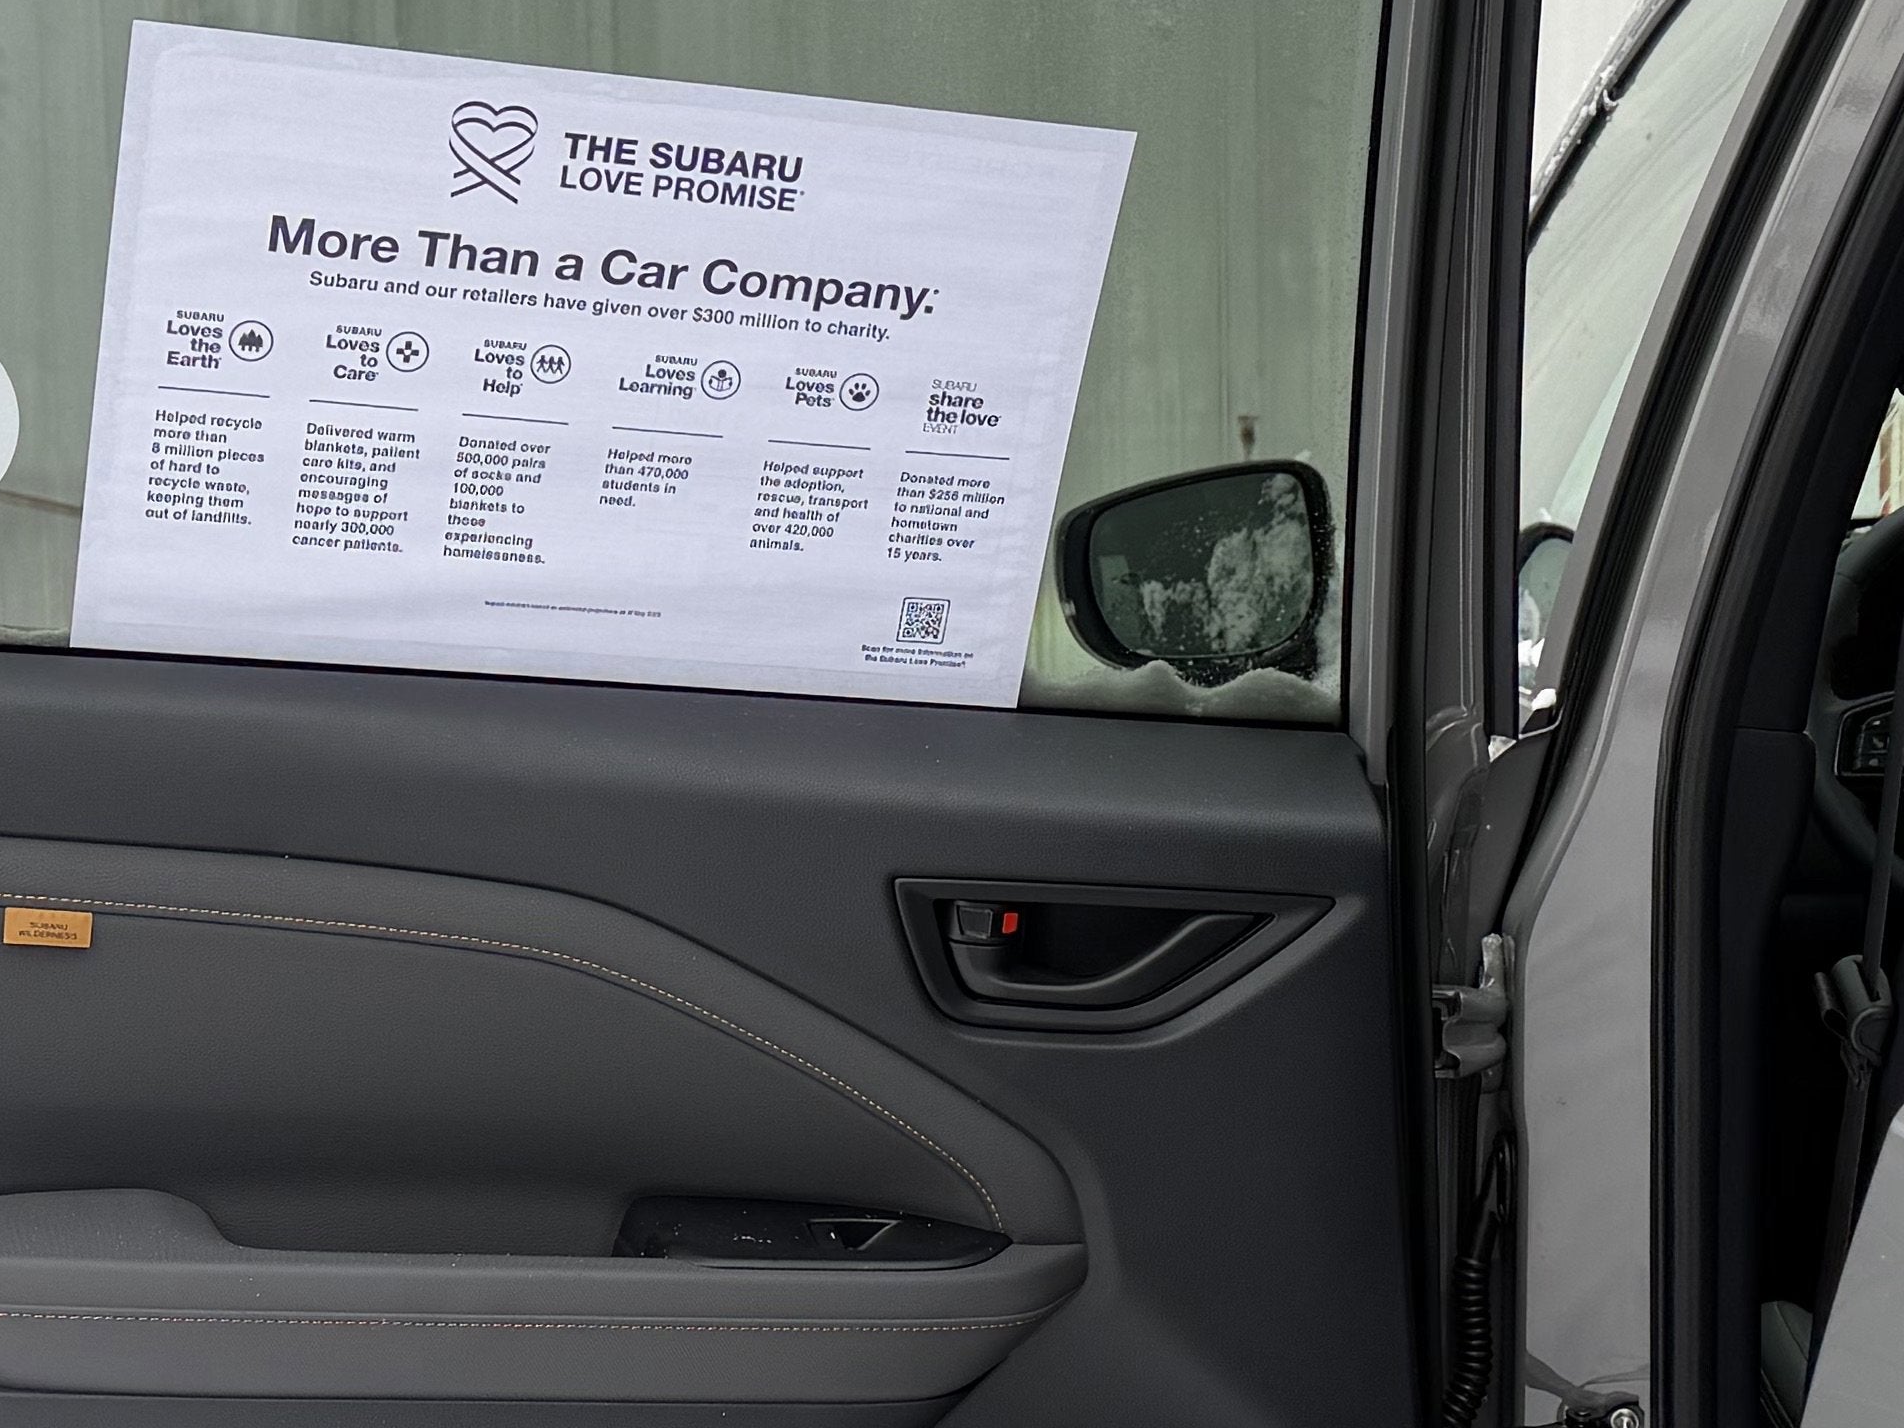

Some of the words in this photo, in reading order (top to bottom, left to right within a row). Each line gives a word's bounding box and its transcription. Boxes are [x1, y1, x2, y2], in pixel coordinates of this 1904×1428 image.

[564, 131, 639, 167] THE
[648, 141, 804, 184] SUBARU
[559, 164, 644, 197] LOVE
[268, 214, 400, 264] More
[417, 229, 539, 278] Than
[554, 253, 584, 282] a
[600, 248, 690, 291] Car
[309, 270, 379, 292] Subaru
[383, 280, 420, 296] and
[424, 285, 458, 299] our
[462, 287, 538, 307] retailers
[543, 292, 587, 311] have
[591, 298, 642, 317] given
[647, 306, 689, 321] over
[692, 306, 735, 325] $300
[739, 312, 800, 331] million
[804, 318, 823, 333] to
[826, 320, 890, 343] charity.
[176, 309, 225, 323] SUBARU
[166, 319, 223, 340] Loves
[335, 324, 383, 338] SUBARU
[190, 337, 222, 354] the
[325, 334, 380, 354] Loves
[483, 338, 528, 351] SUBARU
[166, 350, 222, 370] Earth
[359, 353, 379, 368] to
[473, 347, 525, 367] Loves
[654, 354, 698, 367] SUBARU
[333, 364, 380, 382] Care
[505, 366, 524, 381] to
[645, 363, 696, 382] Loves
[794, 367, 838, 379] SUBARU
[482, 377, 524, 396] Help
[618, 376, 697, 399] Learning
[785, 376, 835, 395] Loves
[931, 378, 978, 393] SUBARU
[794, 391, 835, 408] Pets
[928, 390, 985, 410] share
[155, 409, 207, 427] Helped
[210, 416, 263, 431] recycle
[926, 406, 959, 424] the
[959, 408, 1002, 428] love
[153, 428, 192, 441] more
[195, 429, 228, 444] than
[306, 422, 374, 440] Delivered
[377, 430, 416, 444] warm
[151, 441, 161, 454] 8
[164, 443, 214, 459] million
[217, 448, 265, 463] pieces
[304, 438, 368, 458] blankets,
[371, 445, 421, 460] patient
[458, 435, 517, 452] Donated
[520, 443, 552, 454] over
[302, 457, 334, 469] care
[368, 461, 397, 473] and
[456, 451, 509, 467] 500,000
[511, 457, 546, 470] pairs
[607, 448, 655, 464] Helped
[657, 454, 693, 465] more
[149, 458, 165, 471] of
[168, 459, 203, 474] hard
[205, 463, 221, 476] to
[453, 466, 469, 479] of
[471, 469, 512, 482] socks
[515, 473, 542, 484] and
[604, 462, 635, 476] than
[637, 465, 689, 480] 470,000
[762, 460, 810, 476] Helped
[812, 466, 864, 480] support
[148, 476, 201, 491] recycle
[300, 473, 389, 491] encouraging
[453, 482, 505, 497] 100,000
[601, 479, 660, 493] students
[663, 482, 677, 495] in
[760, 475, 781, 488] the
[783, 477, 845, 494] adoption,
[899, 471, 955, 487] Donated
[956, 478, 991, 490] more
[146, 489, 204, 509] keeping
[208, 494, 244, 508] them
[298, 489, 369, 505] messages
[373, 492, 389, 504] of
[599, 495, 636, 507] need.
[757, 492, 805, 507] rescue,
[808, 494, 869, 511] transport
[896, 486, 926, 499] than
[961, 491, 1005, 505] million
[145, 508, 169, 520] out
[172, 508, 188, 521] of
[295, 501, 332, 518] hope
[335, 505, 350, 517] to
[353, 508, 409, 522] support
[449, 497, 508, 513] blankets
[511, 502, 525, 515] to
[753, 506, 780, 518] and
[782, 507, 823, 522] health
[826, 511, 841, 523] of
[893, 501, 907, 513] to
[909, 503, 962, 517] national
[964, 508, 990, 520] and
[294, 518, 338, 535] nearly
[340, 521, 395, 536] 300,000
[752, 523, 782, 534] over
[784, 523, 835, 538] 420,000
[890, 515, 958, 532] hometown
[291, 535, 341, 548] cancer
[444, 531, 534, 551] experiencing
[749, 537, 804, 552] animals.
[888, 531, 943, 546] charities
[946, 538, 975, 549] over
[887, 546, 902, 559] 15
[903, 550, 942, 562] years.
